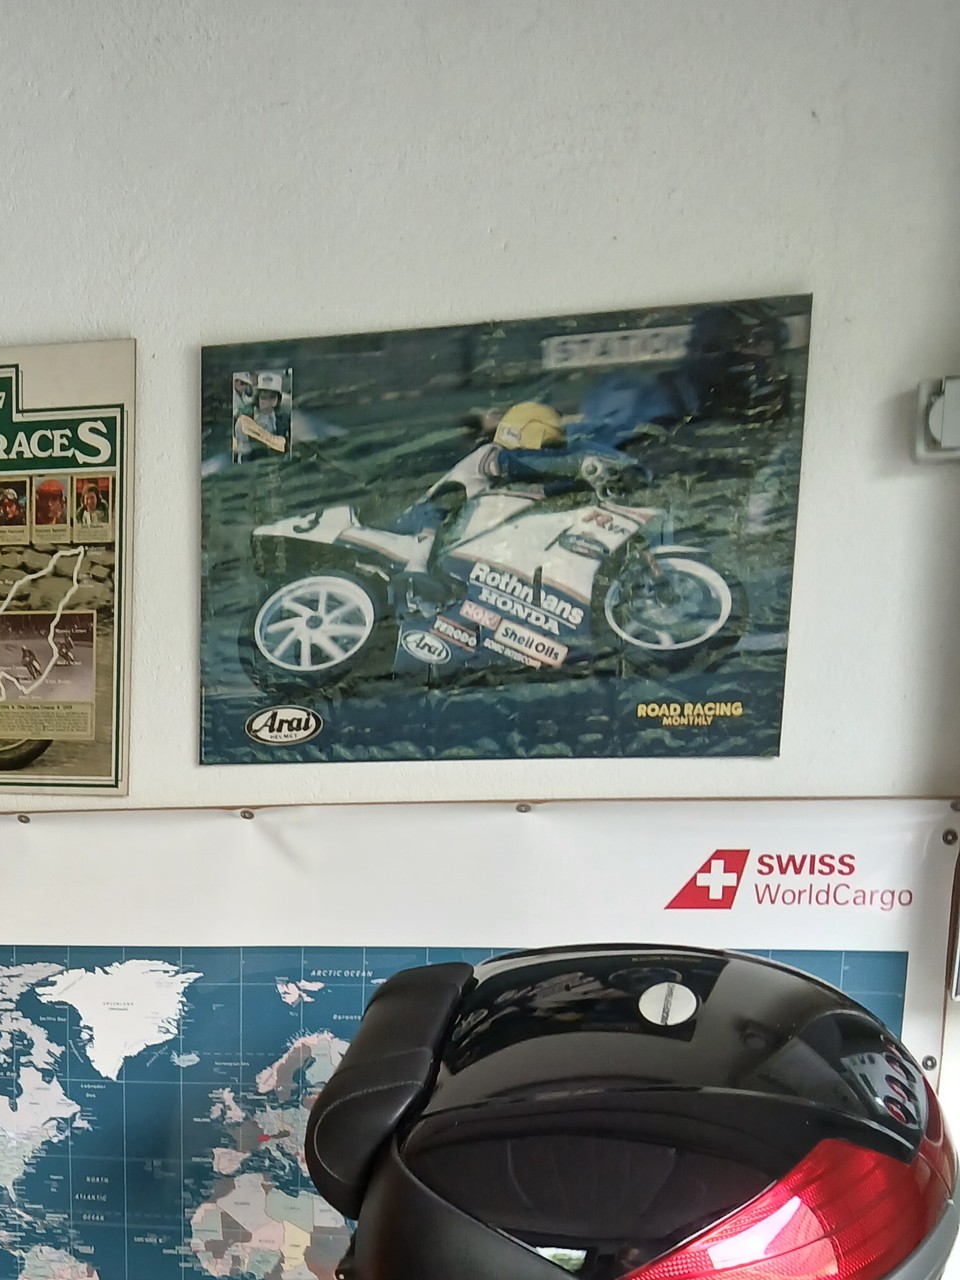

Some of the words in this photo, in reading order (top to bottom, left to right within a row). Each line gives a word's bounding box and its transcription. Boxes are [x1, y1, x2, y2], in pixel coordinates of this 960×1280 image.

[478, 587, 561, 636] HONDA
[501, 626, 534, 655] Shell
[535, 641, 561, 662] Oils
[637, 703, 681, 718] ROAD
[683, 701, 743, 717] RACING
[662, 715, 714, 726] MONTHLY
[250, 709, 313, 735] Arai
[756, 853, 856, 876] SWISS
[754, 882, 914, 912] WorldCargo
[310, 969, 342, 977] ARCTIC
[343, 970, 374, 978] OCEAN
[82, 1213, 105, 1221] OCEAN
